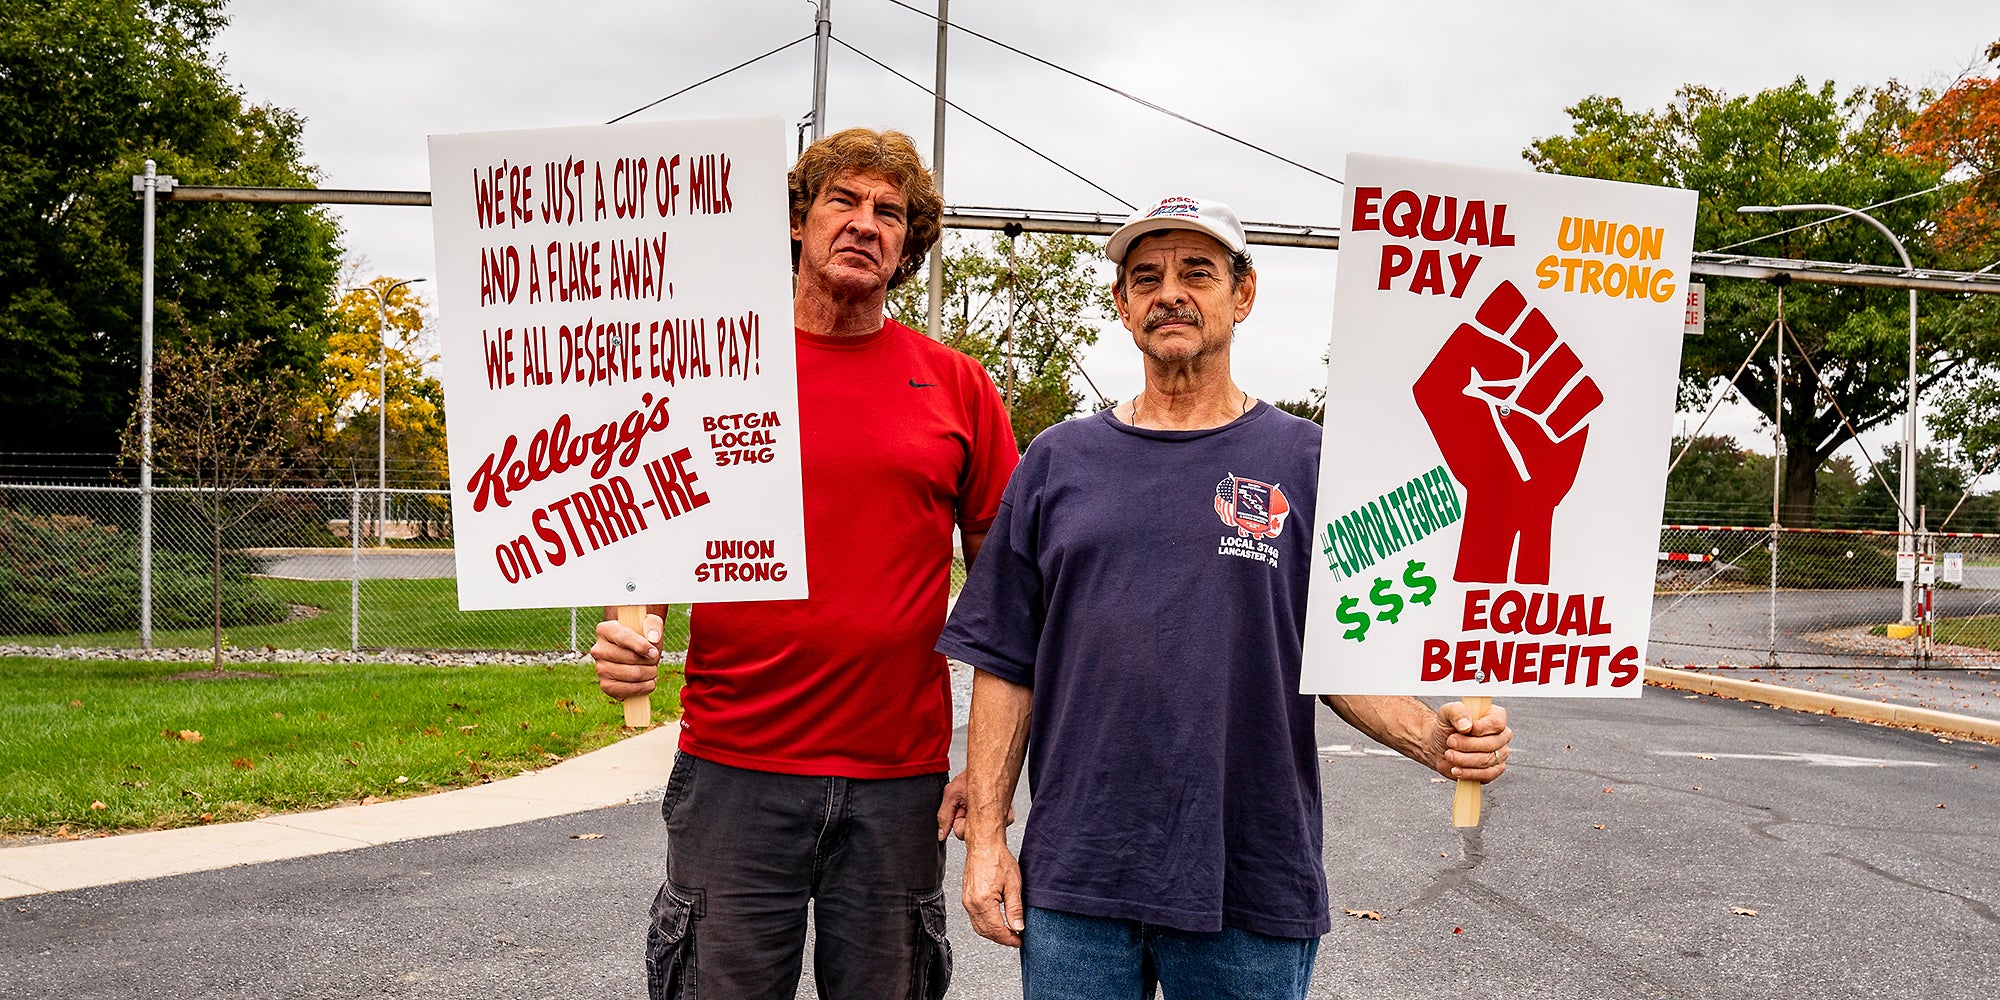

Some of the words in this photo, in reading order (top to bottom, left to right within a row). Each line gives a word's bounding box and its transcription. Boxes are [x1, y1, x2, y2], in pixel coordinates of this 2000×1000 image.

[474, 159, 534, 230] WE'RE
[541, 154, 585, 228] JUST
[595, 160, 607, 222] A
[614, 157, 648, 220] CUP
[656, 153, 681, 218] OF
[690, 152, 732, 215] MILK
[1352, 187, 1516, 248] EQUAL
[1557, 216, 1665, 261] UNION
[482, 244, 520, 308] AND
[529, 244, 542, 305] A
[548, 239, 602, 303] FLAKE
[610, 231, 674, 303] AWAY,
[1378, 245, 1482, 299] PAY
[1535, 254, 1676, 304] STRONG
[484, 328, 516, 391] WE
[523, 325, 553, 388] ALL
[560, 316, 642, 388] DESERVE
[650, 317, 711, 387] EQUAL
[717, 310, 760, 381] PAY!
[703, 412, 781, 432] BCTGM
[710, 430, 777, 449] LOCAL
[467, 392, 670, 512] Kellogg's
[715, 449, 775, 467] 374G
[496, 533, 543, 585] on
[532, 446, 711, 567] STRRR-IKE
[1320, 465, 1462, 582] #CORPORATEGREED
[694, 562, 786, 582] STRONG
[706, 540, 775, 560] UNION
[1218, 546, 1266, 562] LANCASTER
[1220, 536, 1255, 550] LOCAL
[1256, 542, 1279, 560] 374G
[1462, 589, 1612, 636] EQUAL
[1421, 639, 1639, 688] BENEFITS
